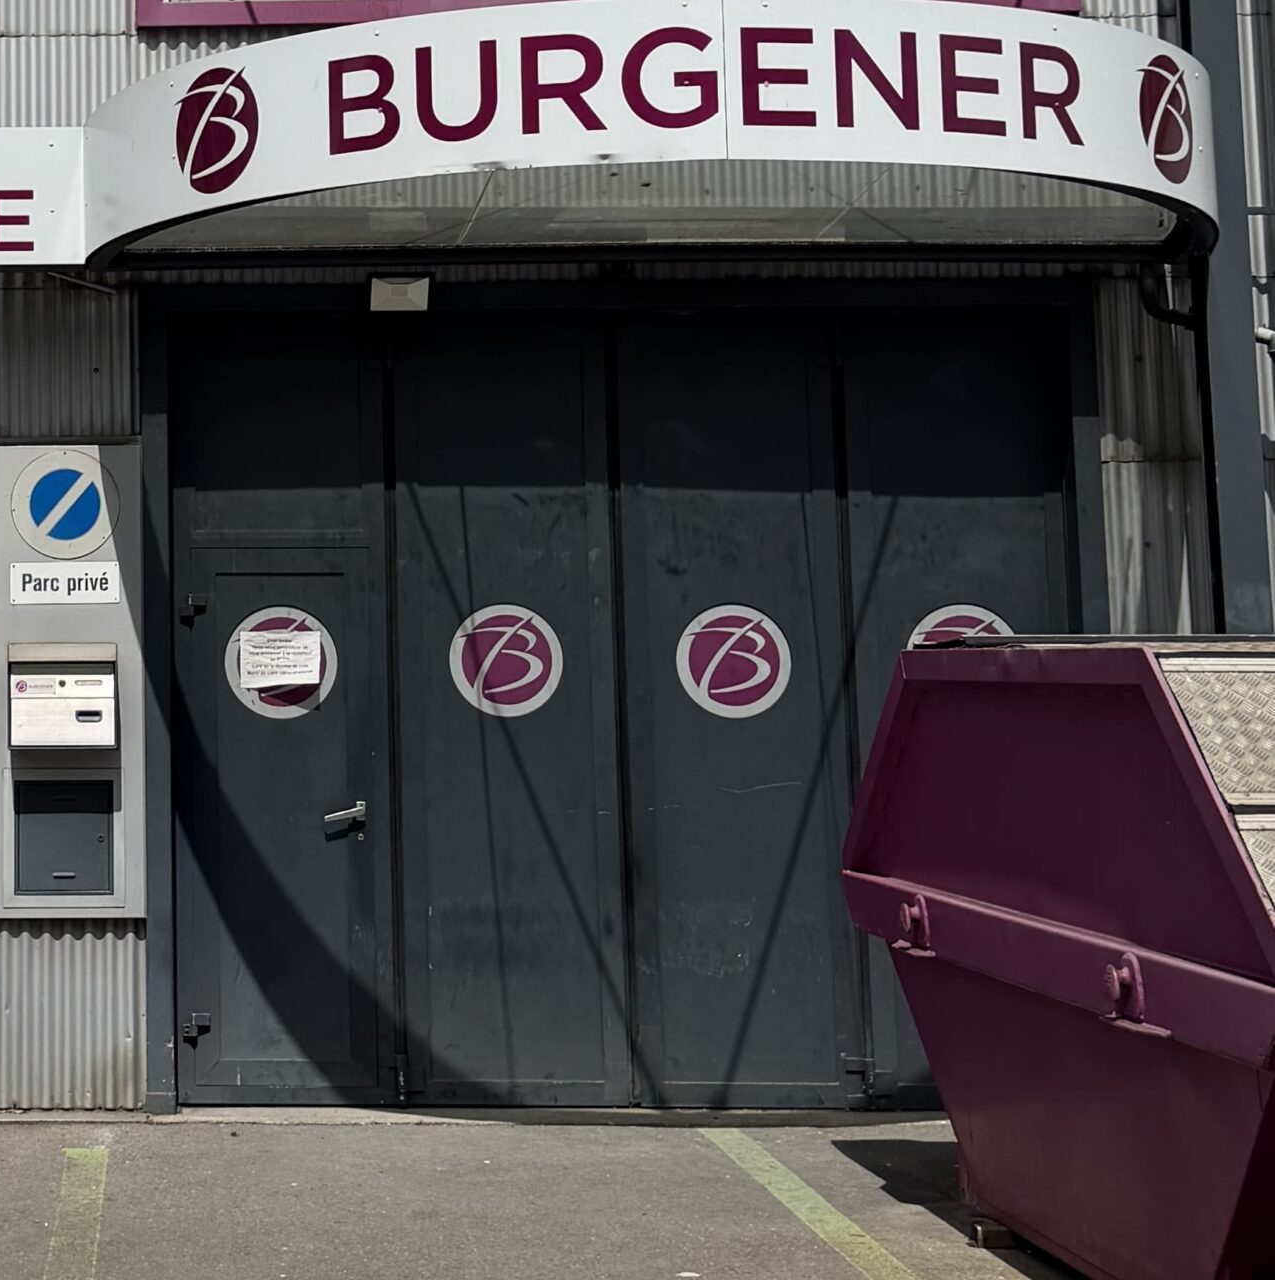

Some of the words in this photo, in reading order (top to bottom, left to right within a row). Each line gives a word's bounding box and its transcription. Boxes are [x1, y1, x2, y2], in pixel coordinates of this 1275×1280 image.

[328, 26, 1086, 156] BURGENER
[21, 572, 60, 592] Parc
[67, 571, 109, 596] privé
